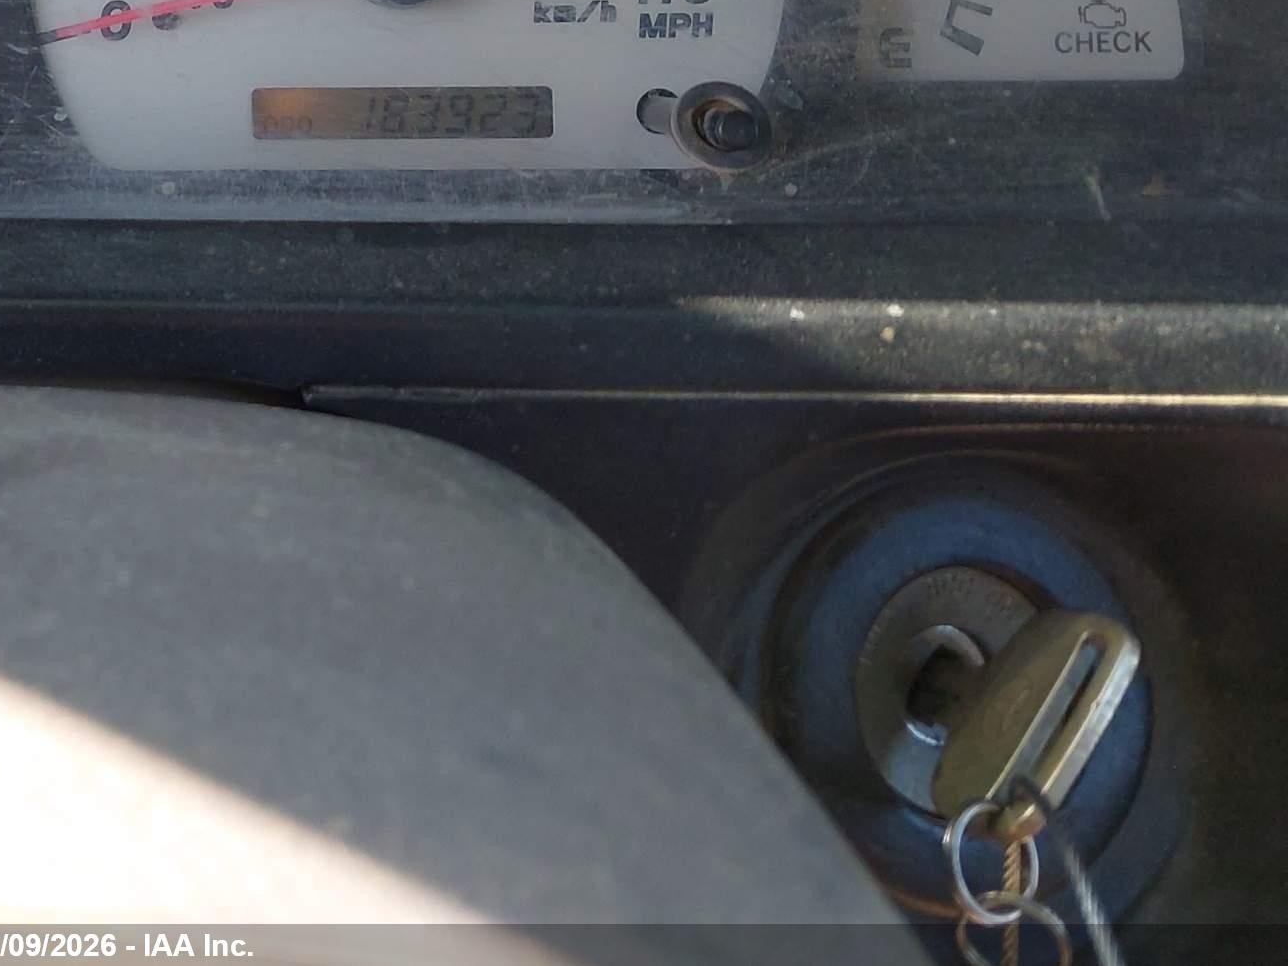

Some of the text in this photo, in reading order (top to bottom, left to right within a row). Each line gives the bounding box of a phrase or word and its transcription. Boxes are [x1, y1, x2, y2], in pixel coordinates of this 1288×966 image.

[99, 0, 132, 41] 0
[638, 12, 714, 38] MPH
[1055, 31, 1153, 53] CHECK
